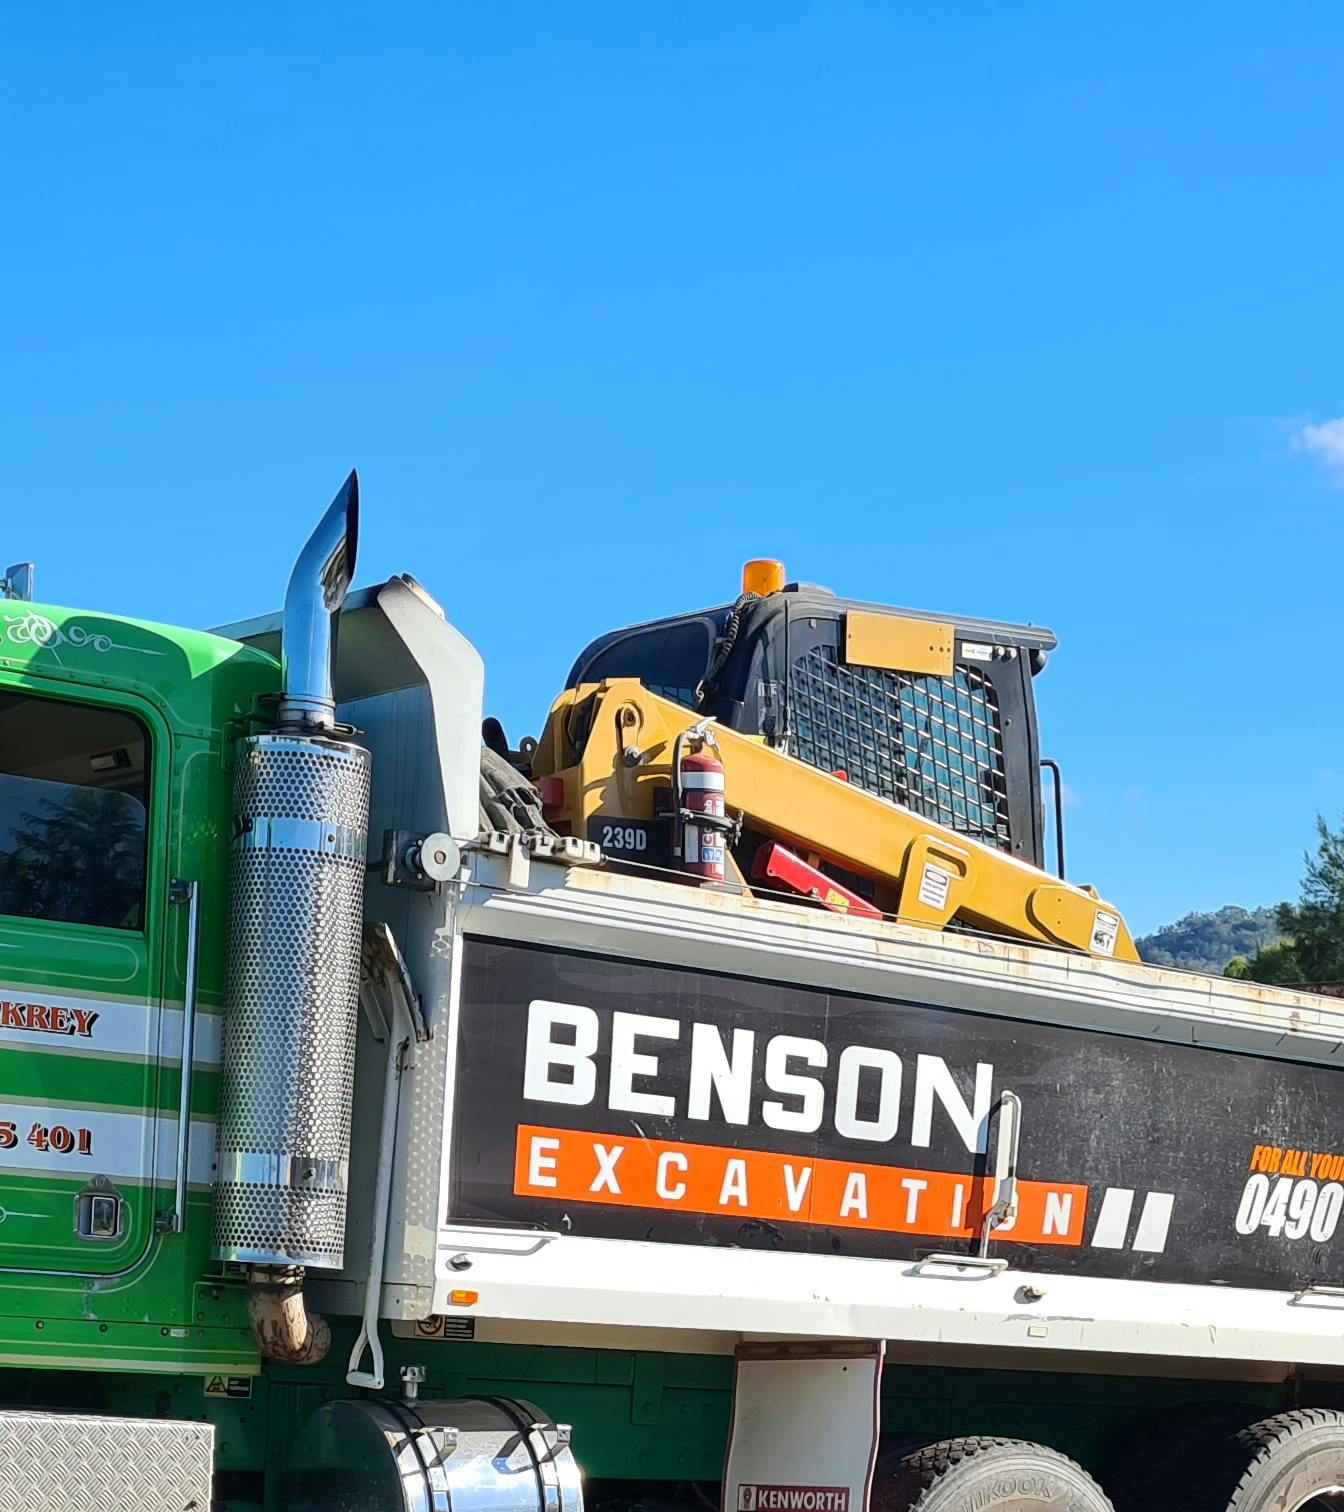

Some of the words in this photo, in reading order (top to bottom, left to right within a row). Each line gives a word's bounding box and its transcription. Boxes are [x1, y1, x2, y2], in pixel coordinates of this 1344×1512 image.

[602, 825, 647, 851] 239D
[523, 999, 994, 1155] BENSON
[26, 1122, 94, 1156] 401
[1249, 1145, 1283, 1174] FOR
[1280, 1149, 1308, 1177] ALL
[1235, 1174, 1344, 1243] 0490
[758, 1489, 846, 1511] KENWORTH
